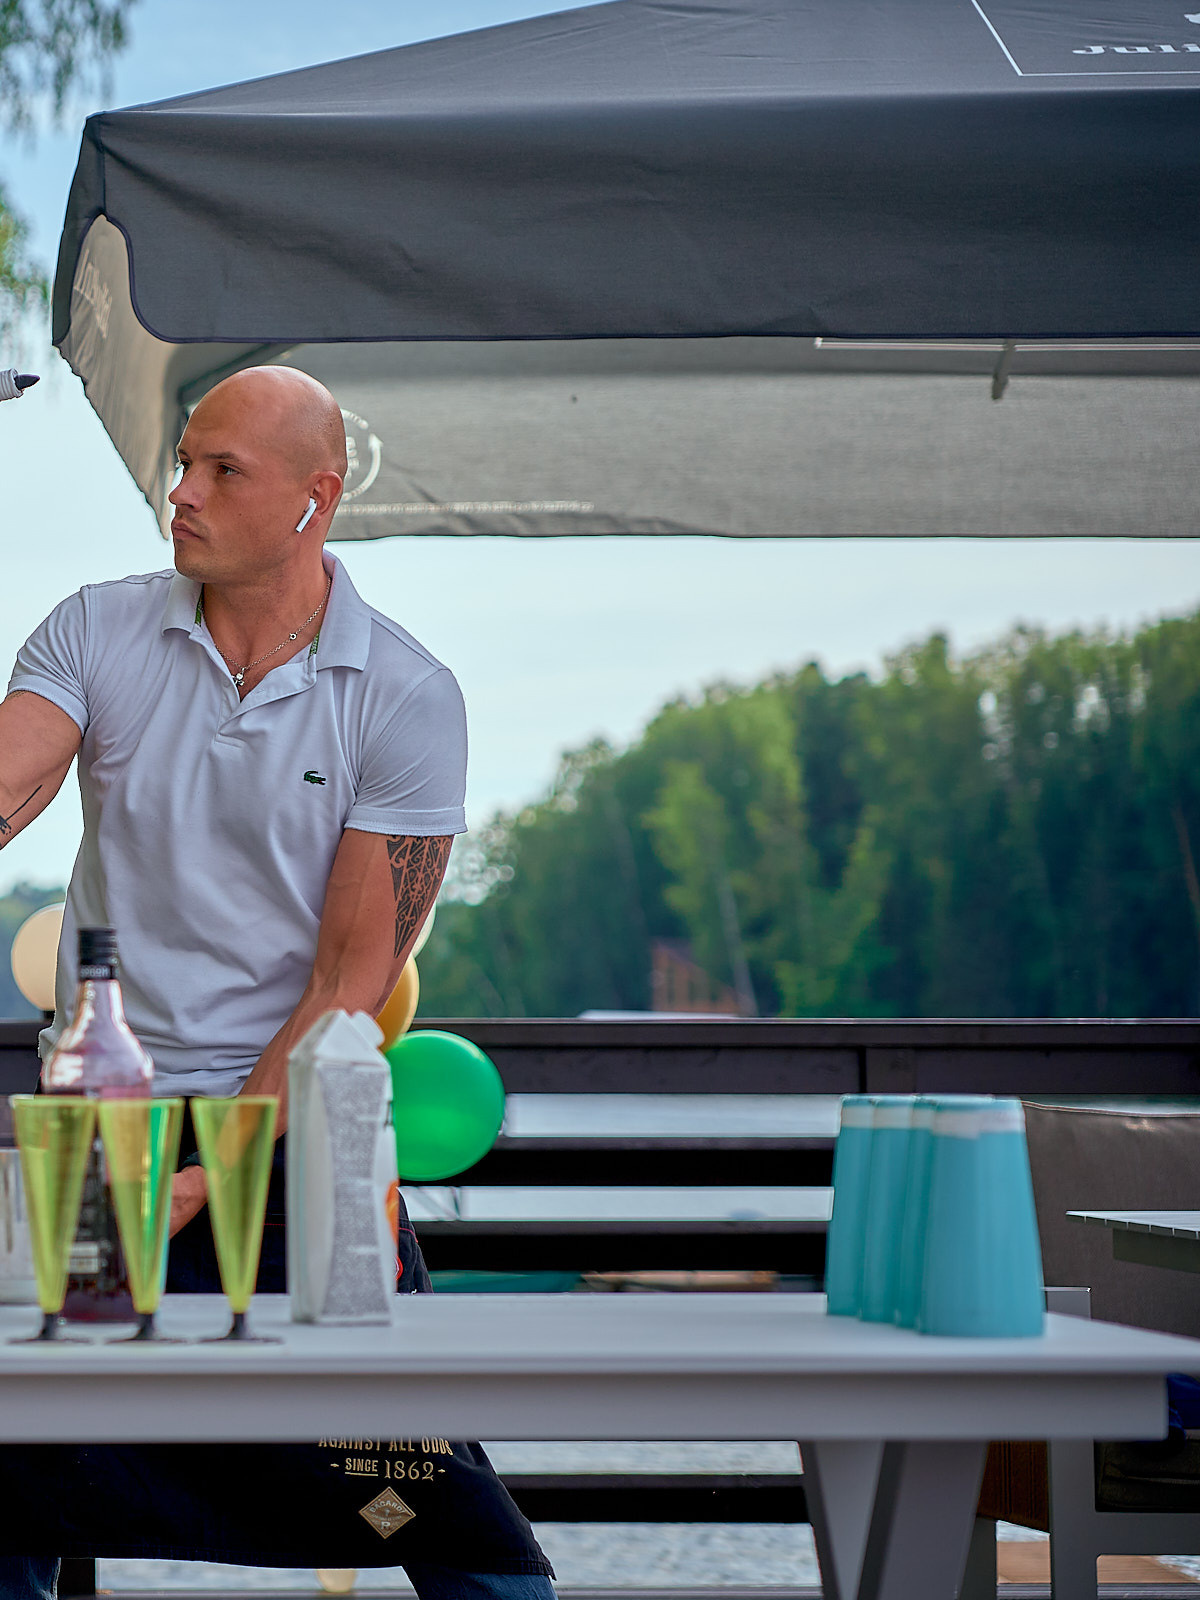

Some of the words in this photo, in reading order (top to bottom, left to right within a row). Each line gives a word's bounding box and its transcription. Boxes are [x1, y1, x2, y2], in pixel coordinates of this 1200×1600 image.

[318, 1434, 380, 1452] AGAINST
[387, 1436, 415, 1452] ALL
[344, 1457, 378, 1472] SINCE
[383, 1459, 435, 1481] 1862
